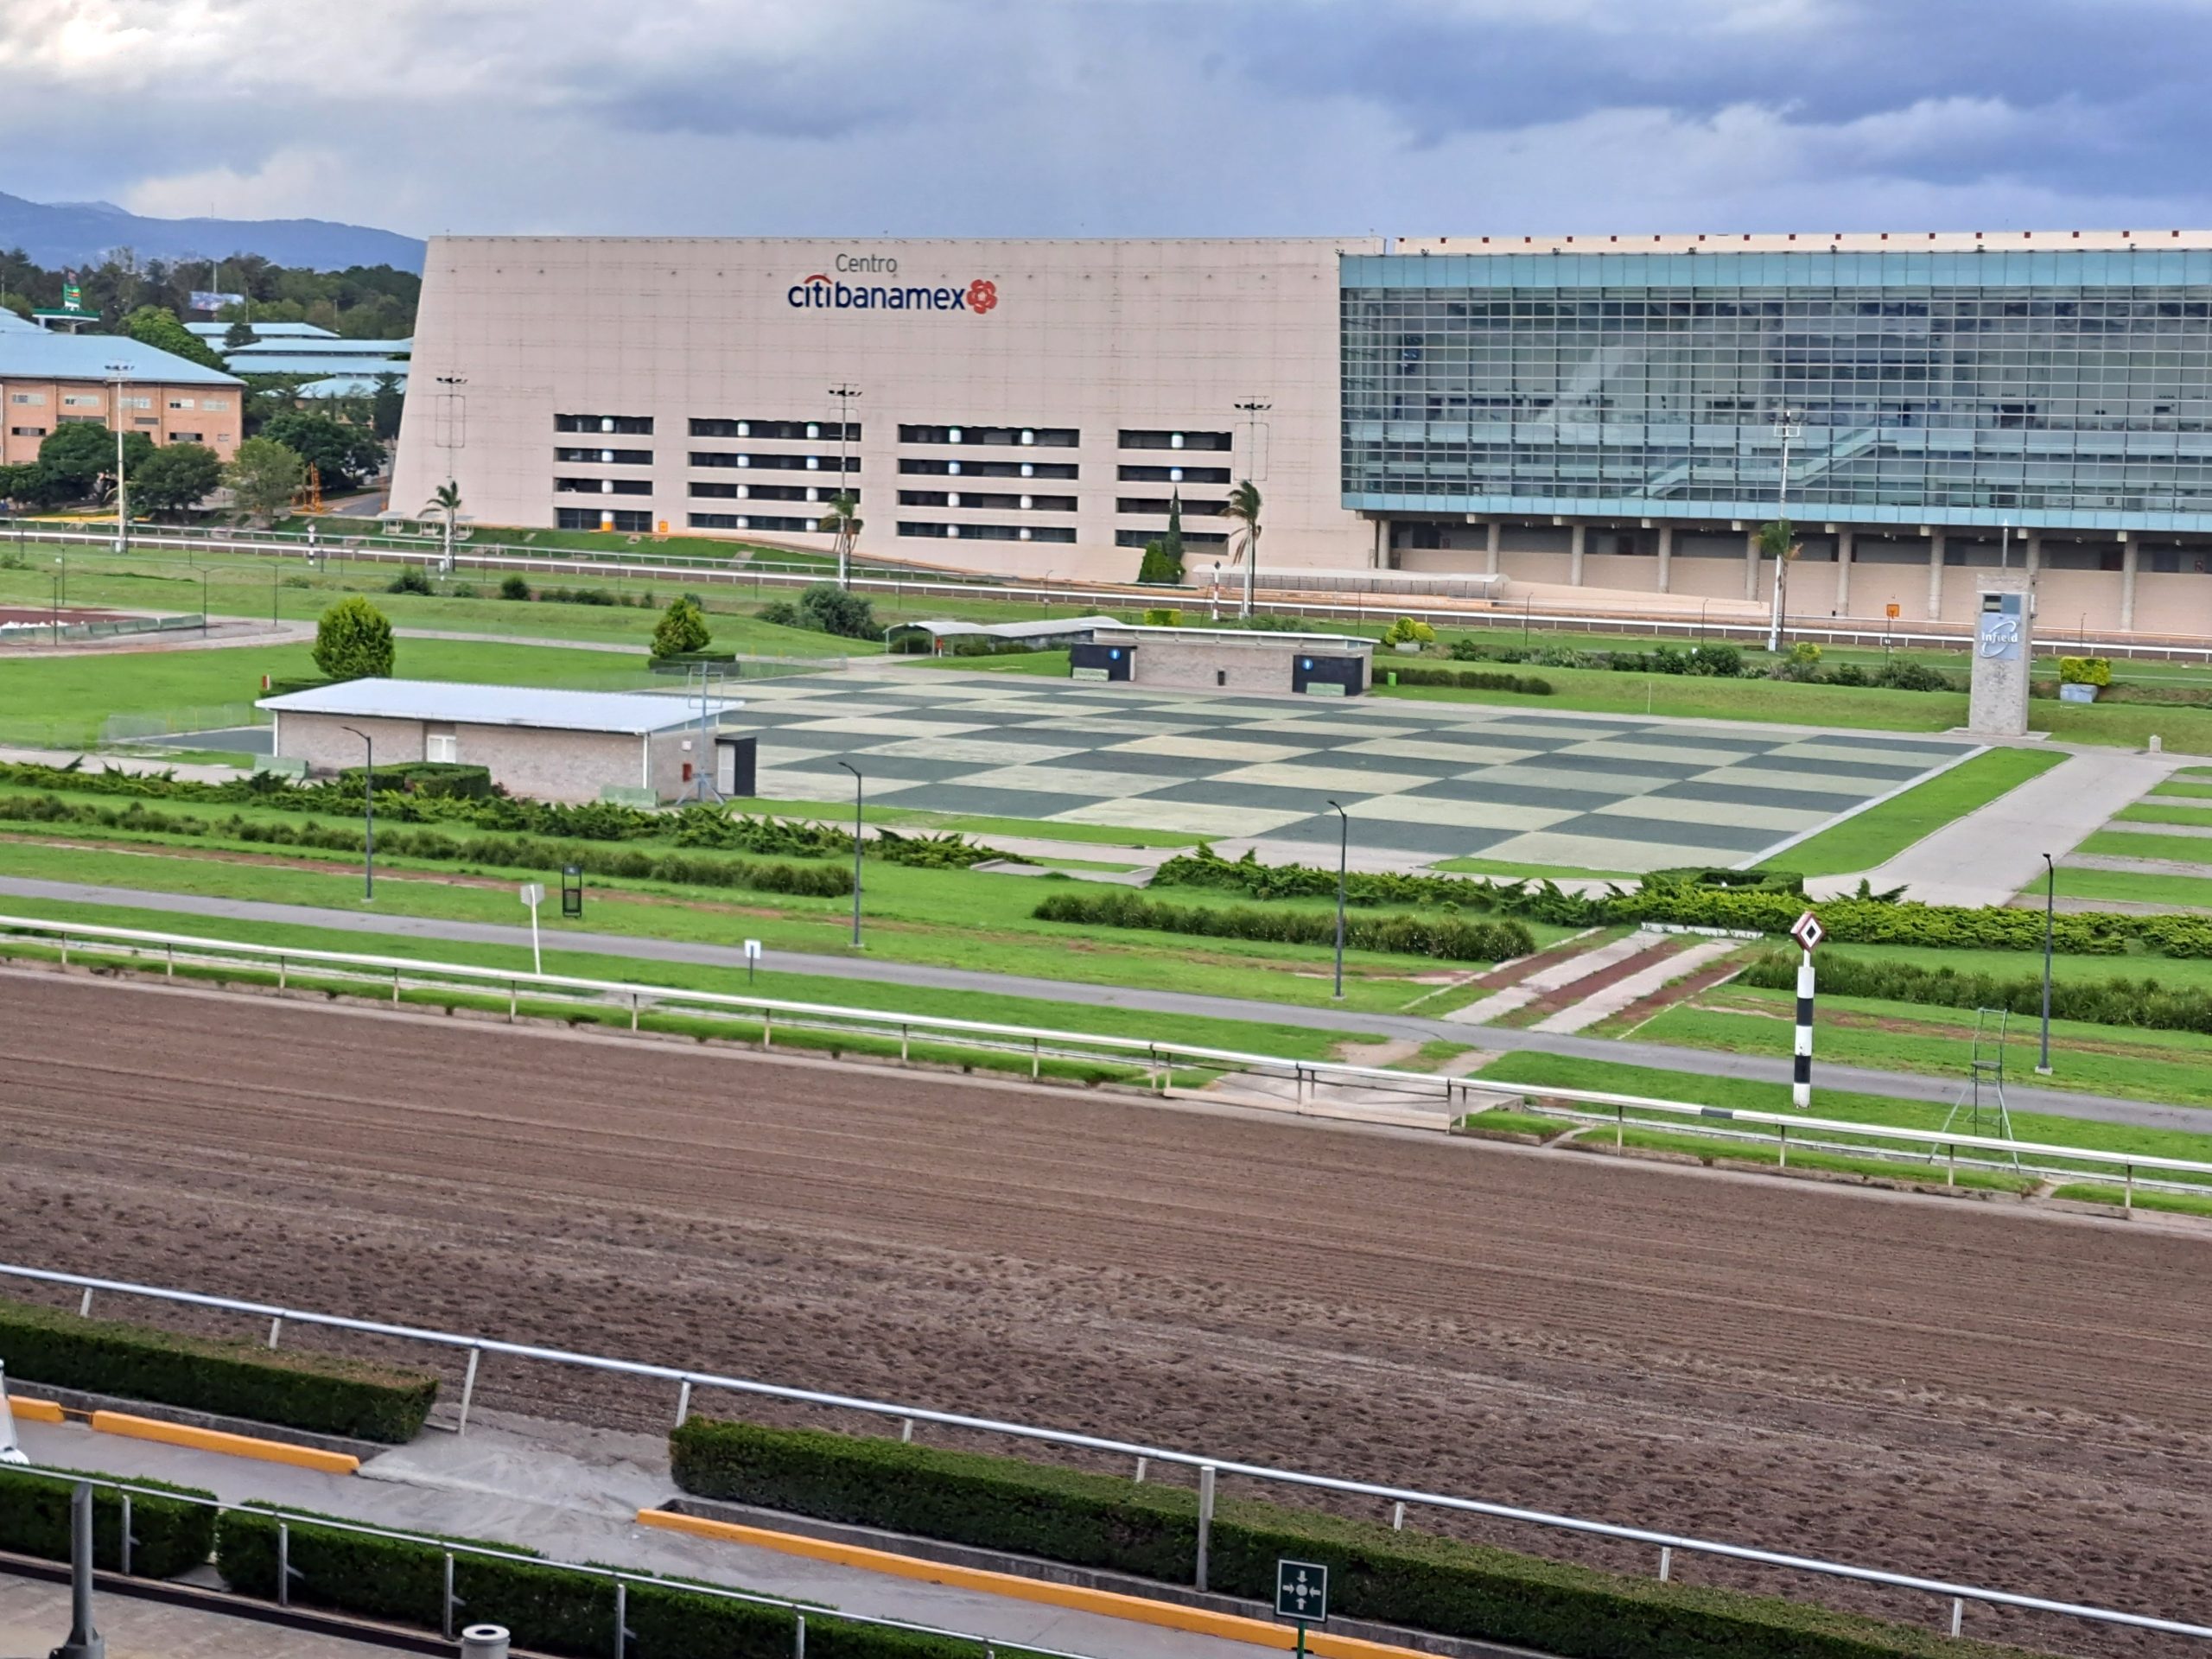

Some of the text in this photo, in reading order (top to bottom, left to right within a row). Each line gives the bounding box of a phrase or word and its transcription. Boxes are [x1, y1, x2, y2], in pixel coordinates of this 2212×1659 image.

[836, 253, 898, 272] Centro
[788, 281, 965, 310] citibanamex
[1981, 632, 2018, 644] Infield
